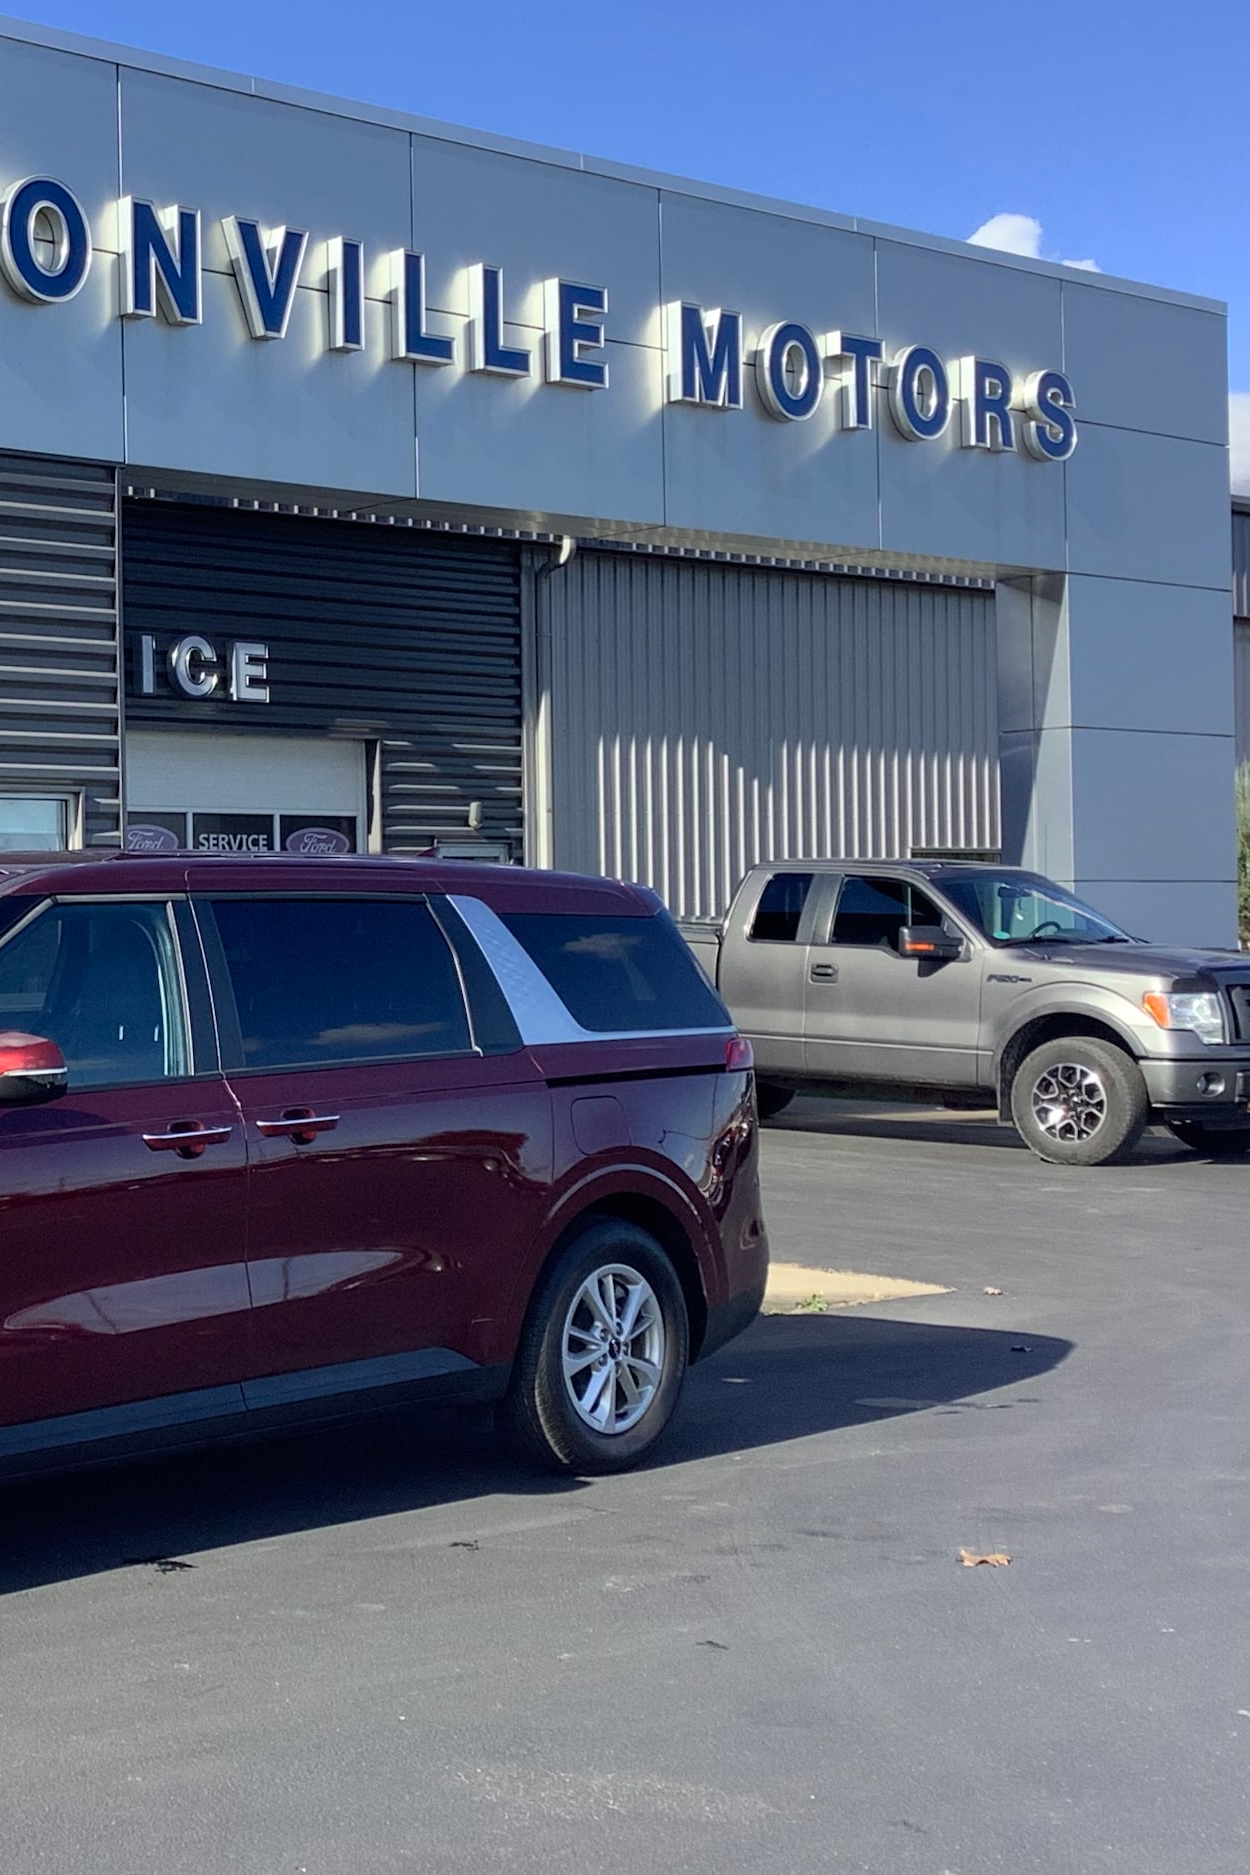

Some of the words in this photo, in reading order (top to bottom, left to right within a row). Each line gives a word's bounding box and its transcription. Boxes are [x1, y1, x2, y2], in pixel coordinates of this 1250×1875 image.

[664, 300, 1079, 462] MOTORS
[140, 634, 270, 703] ICE
[127, 829, 165, 850] Ford
[198, 833, 268, 851] SERVICE
[299, 832, 337, 854] Ford
